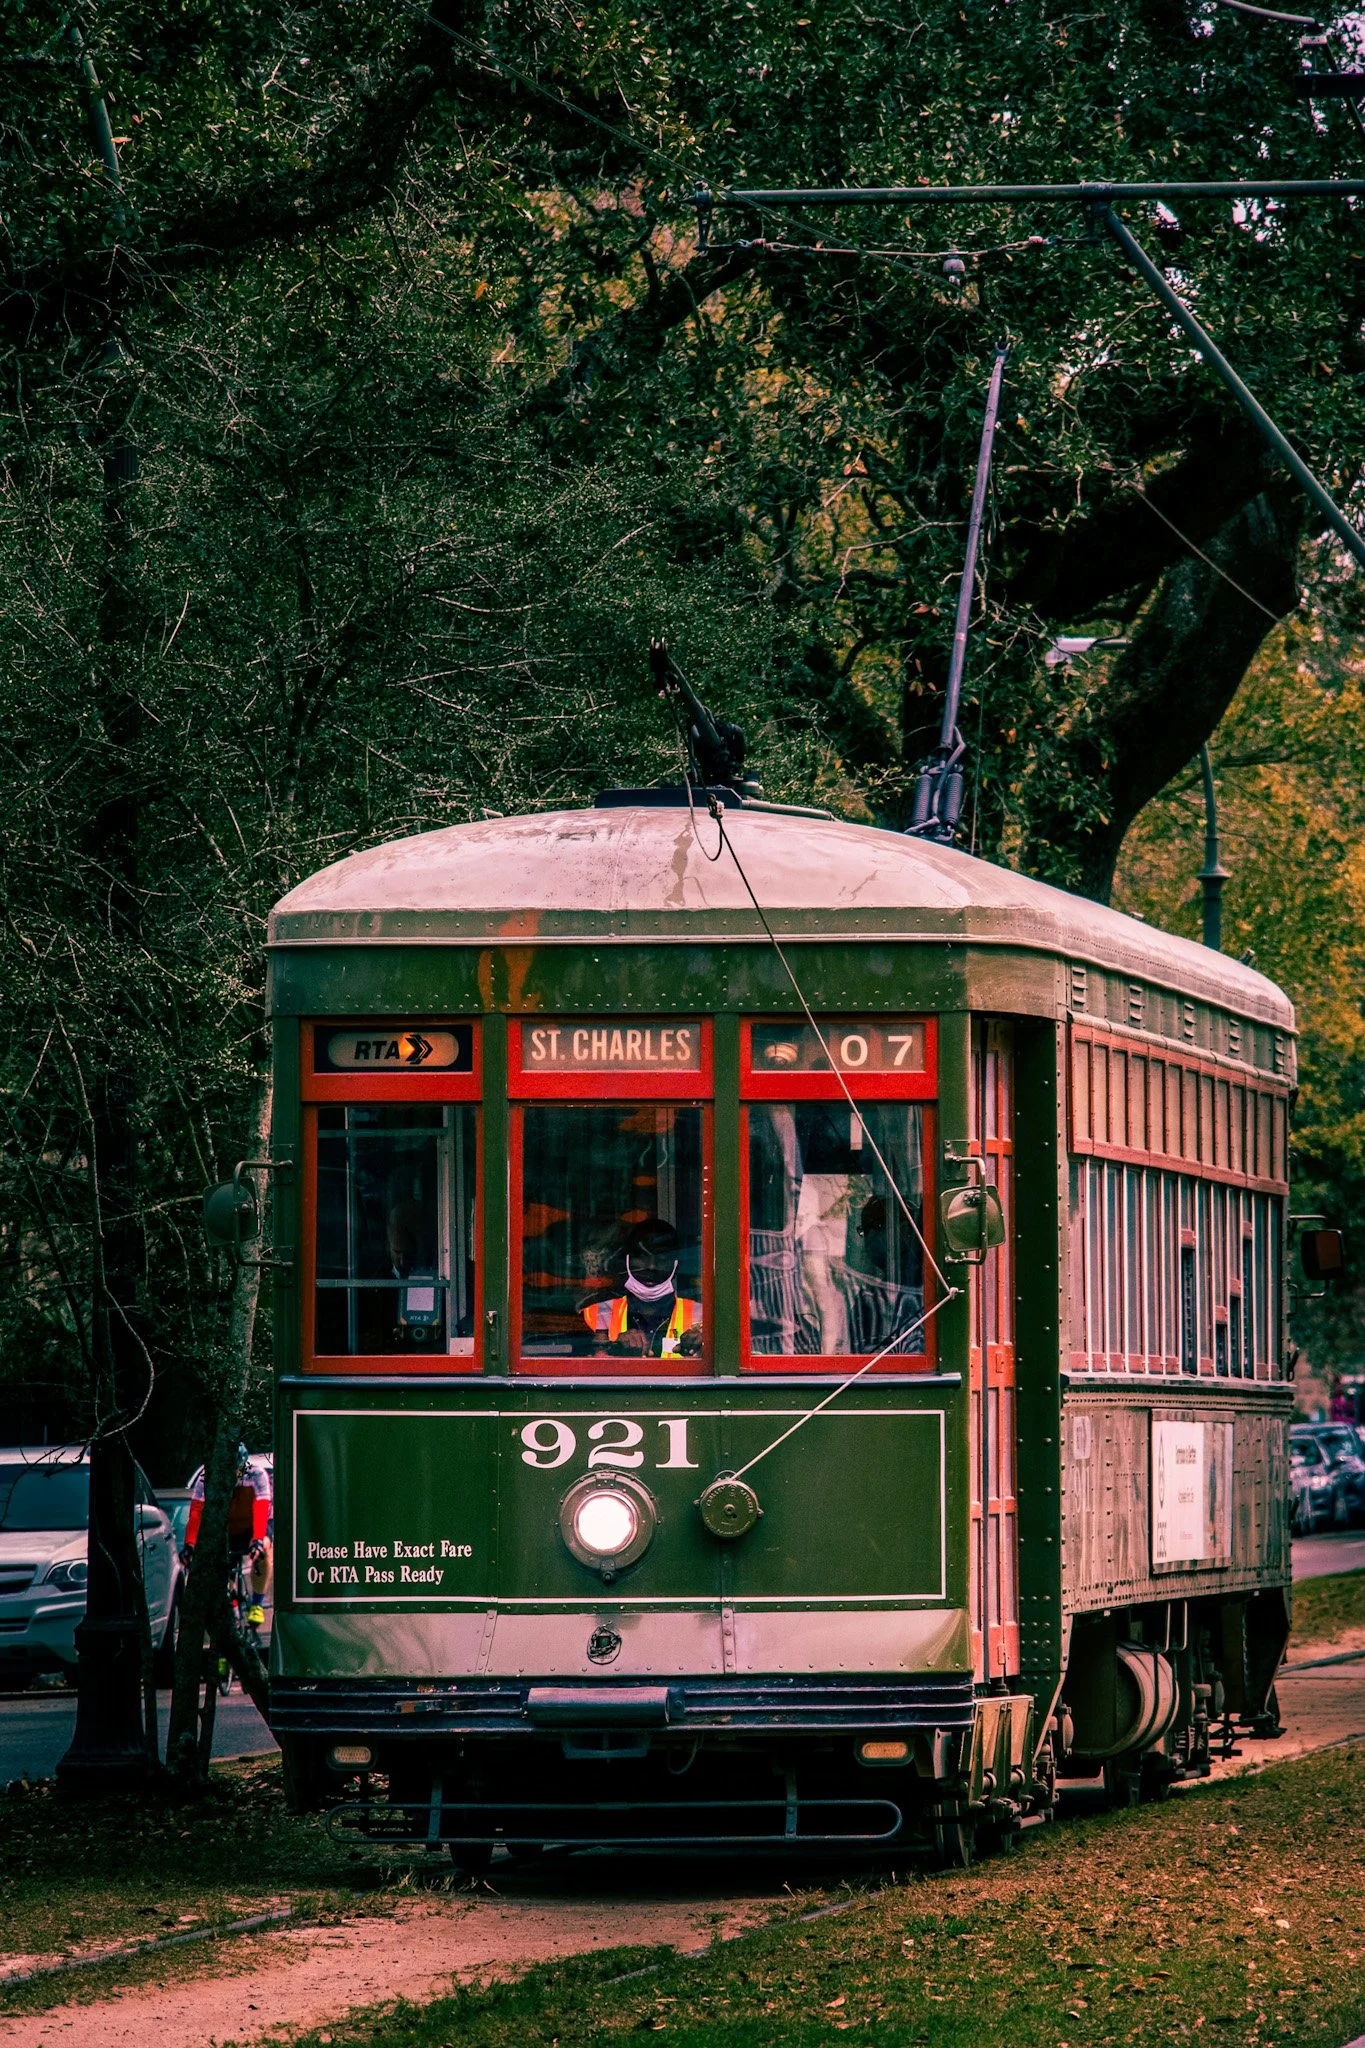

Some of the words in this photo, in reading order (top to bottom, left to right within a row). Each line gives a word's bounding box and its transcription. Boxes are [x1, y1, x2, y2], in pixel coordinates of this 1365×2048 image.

[354, 1040, 400, 1060] RTA
[531, 1029, 565, 1061] ST.
[572, 1029, 691, 1061] CHARLES
[521, 1418, 700, 1469] 921
[307, 1541, 348, 1559] Please
[353, 1541, 388, 1559] Have
[393, 1540, 435, 1558] Exact
[440, 1540, 473, 1558] Fare
[307, 1566, 325, 1584] Or
[329, 1566, 360, 1584] RTA
[364, 1565, 395, 1583] Pass
[400, 1565, 444, 1586] Ready
